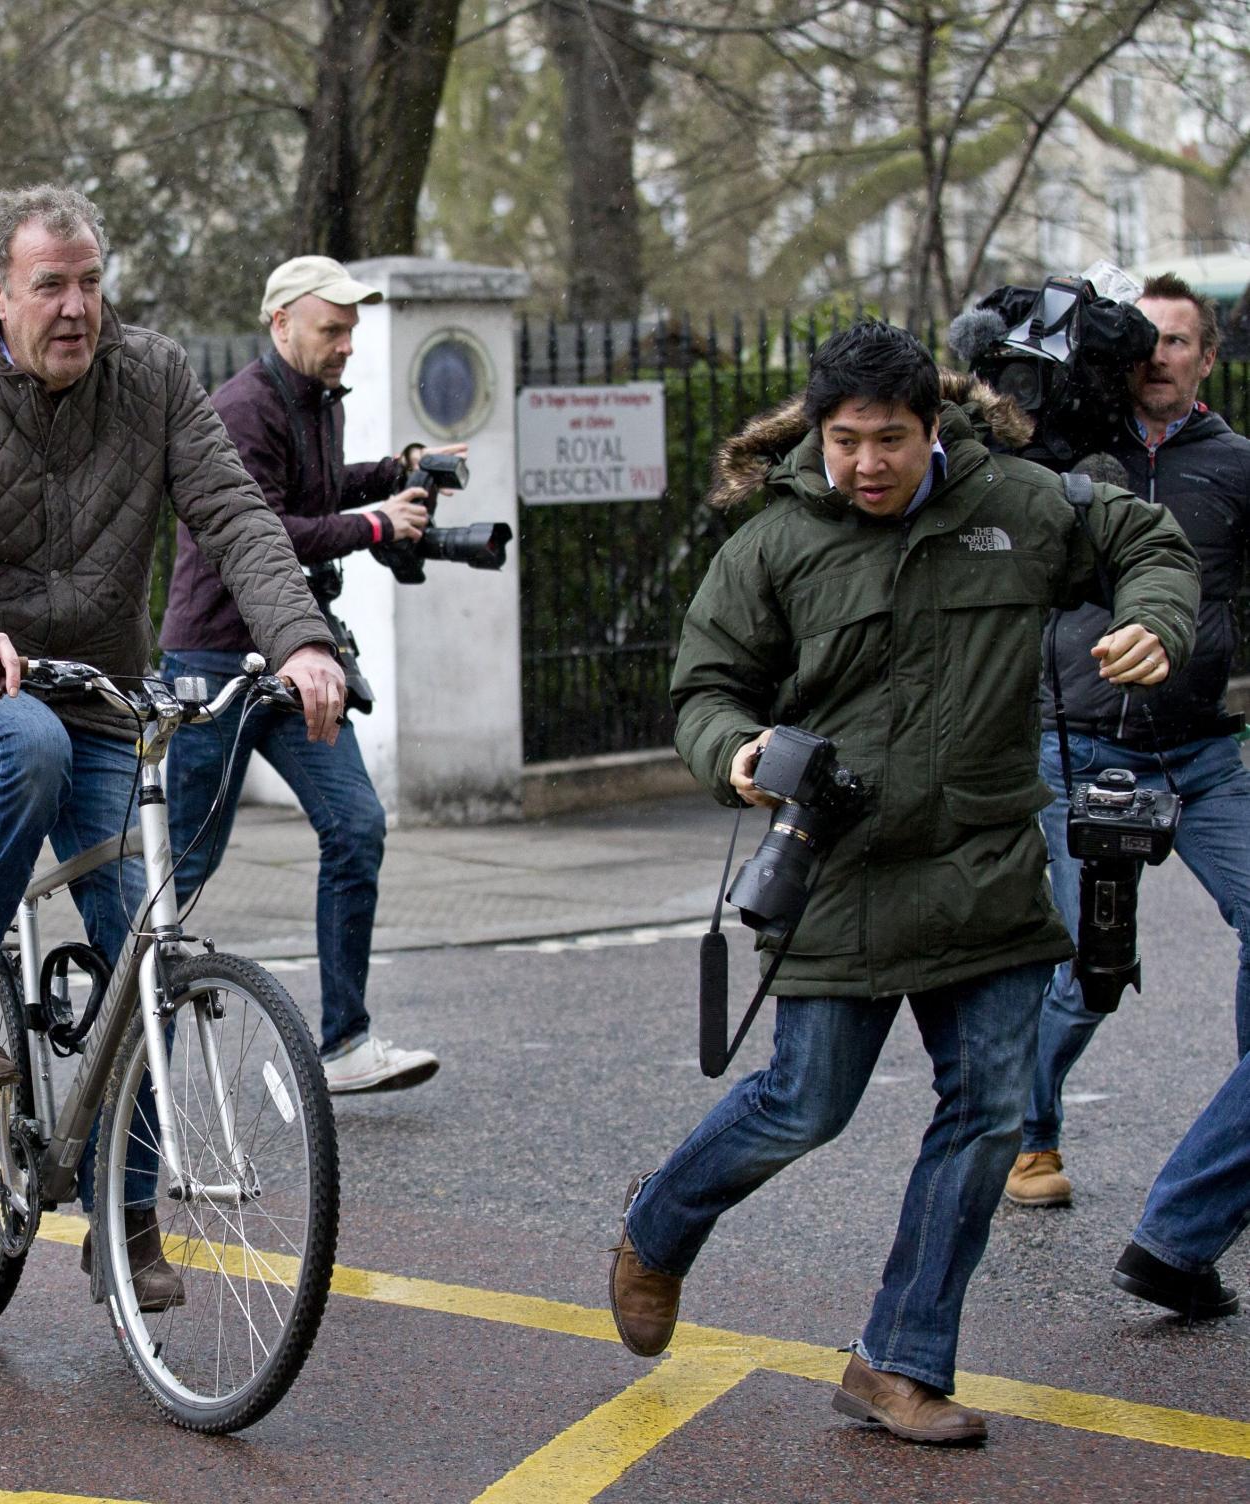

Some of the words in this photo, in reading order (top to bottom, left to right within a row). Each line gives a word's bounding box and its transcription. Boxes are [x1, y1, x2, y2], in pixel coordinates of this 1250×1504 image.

[556, 437, 626, 463] ROYAL
[523, 466, 623, 496] CRESCENT
[972, 526, 993, 536] THE
[958, 534, 993, 544] NORTH
[969, 543, 995, 552] FACE
